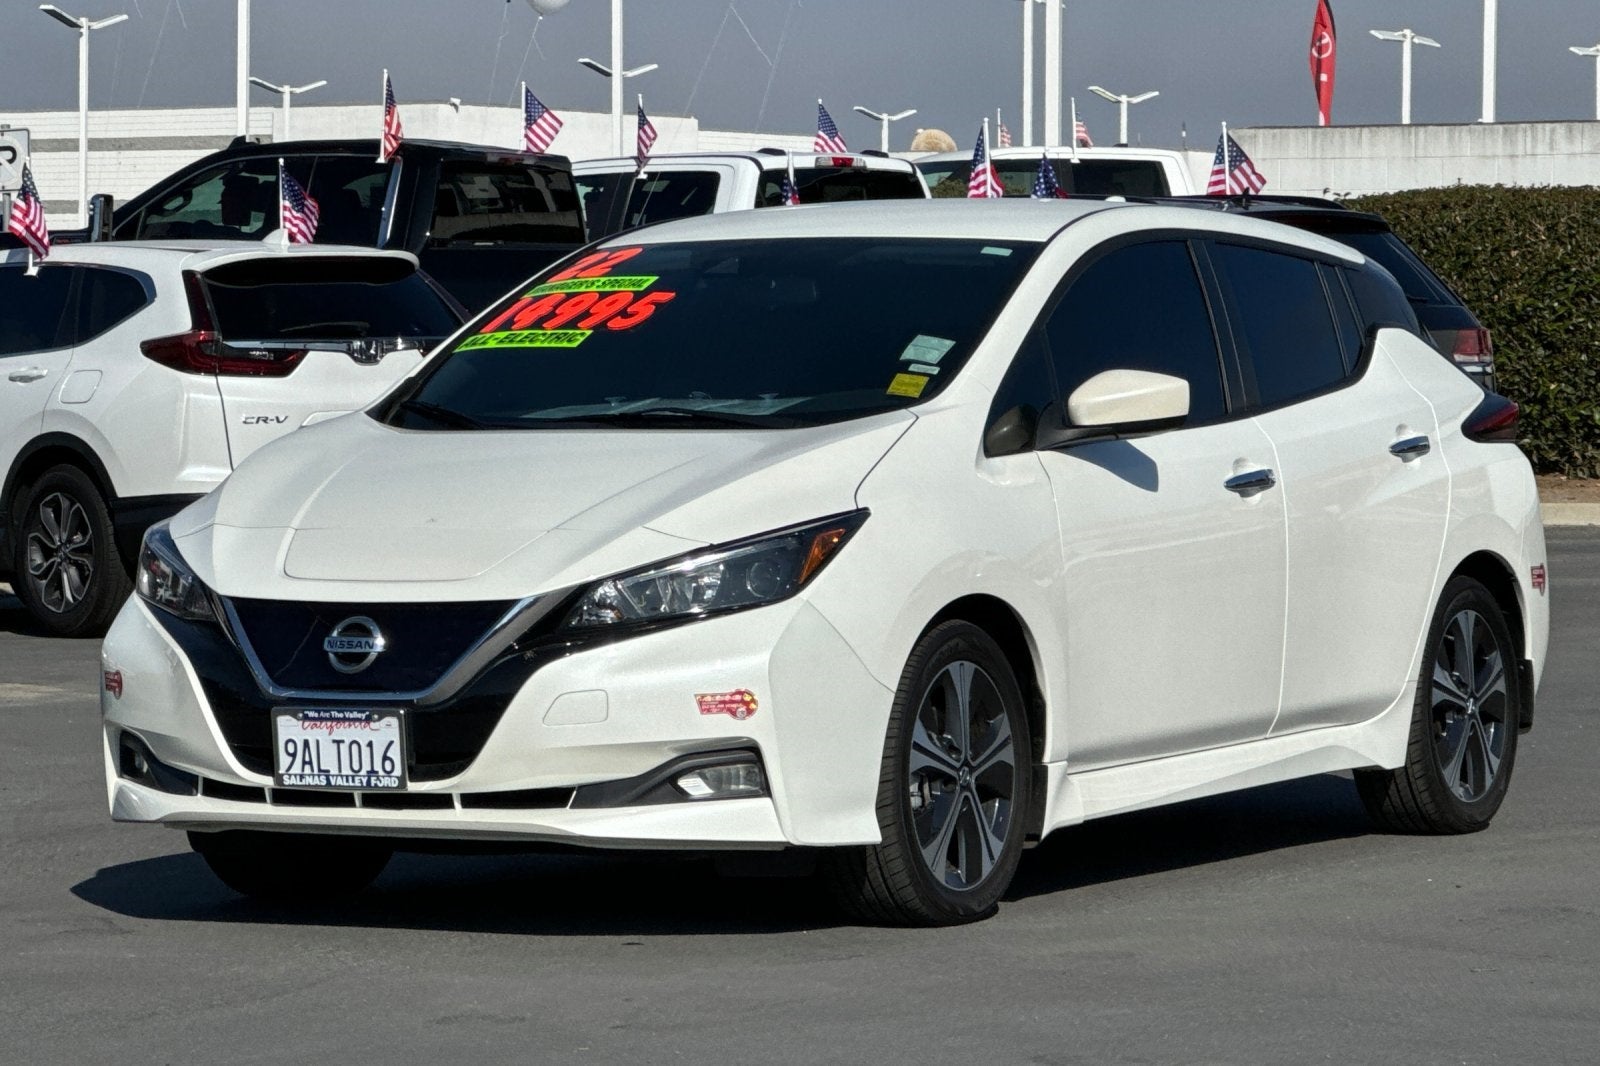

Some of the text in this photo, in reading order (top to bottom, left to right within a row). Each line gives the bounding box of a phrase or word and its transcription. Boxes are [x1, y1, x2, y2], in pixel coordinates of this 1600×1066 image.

[546, 247, 643, 283] 22
[597, 278, 650, 289] SPECIAL
[479, 291, 675, 333] 14995
[462, 332, 586, 348] ALL-ELECTRIC
[242, 415, 288, 425] CR-V
[326, 639, 374, 650] NISSAN
[331, 711, 344, 719] The
[345, 711, 370, 720] Valley"
[301, 720, 380, 736] California
[284, 738, 395, 775] 9ALT016
[330, 776, 367, 787] VALLEY
[371, 776, 399, 788] FORD
